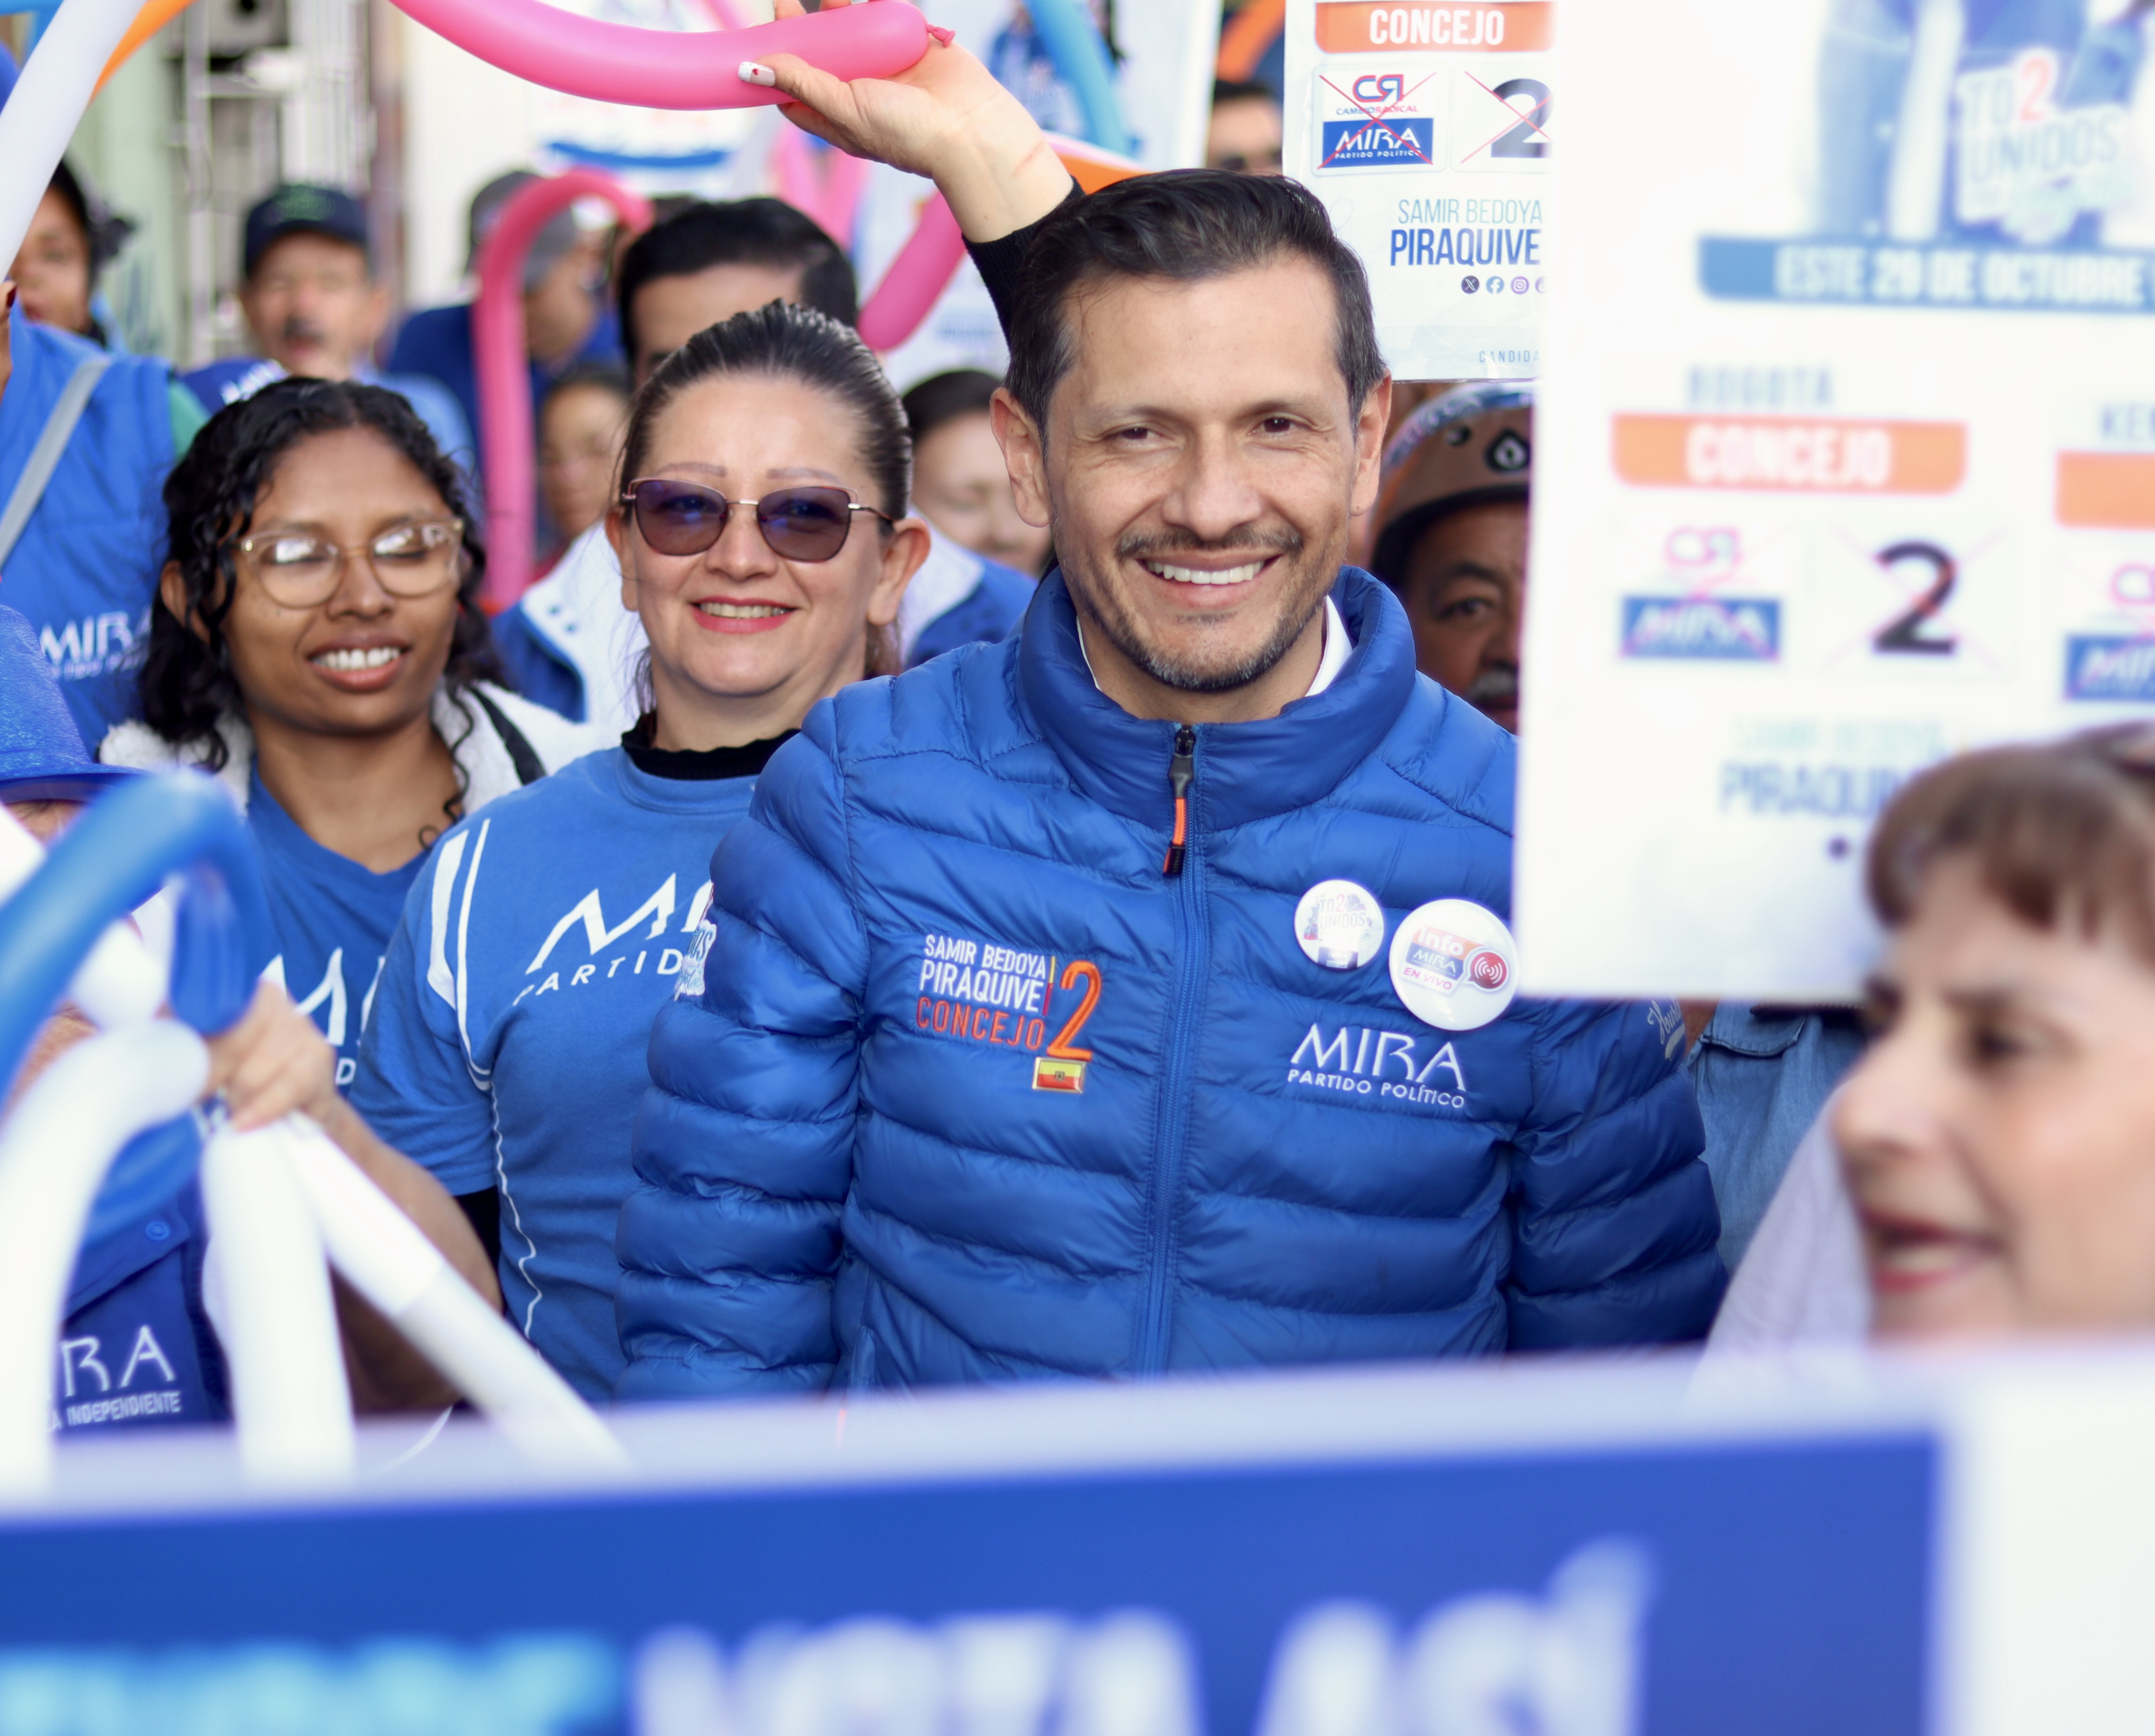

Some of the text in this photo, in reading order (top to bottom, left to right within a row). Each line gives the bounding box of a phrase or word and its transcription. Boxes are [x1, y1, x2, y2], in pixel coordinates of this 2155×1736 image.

[1370, 9, 1504, 45] CONCEJO
[1490, 78, 1553, 158] 2
[1334, 127, 1421, 152] MIRA
[1398, 198, 1543, 224] SAMIR BEDOYA
[1390, 228, 1543, 267] PIRAQUIVE
[1685, 424, 1892, 487] CONCEJO
[1872, 539, 1957, 657] 2
[920, 934, 1046, 979] SAMIR BEDOYA
[1412, 949, 1456, 973] MIRA
[919, 959, 1044, 1013] PIRAQUIVE
[1403, 967, 1452, 990] EN VIVO
[916, 996, 1045, 1051] CONCEJO
[1046, 960, 1102, 1062] 2
[1290, 1023, 1466, 1092] MIRA
[1287, 1069, 1465, 1108] PARTIDO POLÍTICO
[66, 1390, 183, 1427] INDEPENDIENTE
